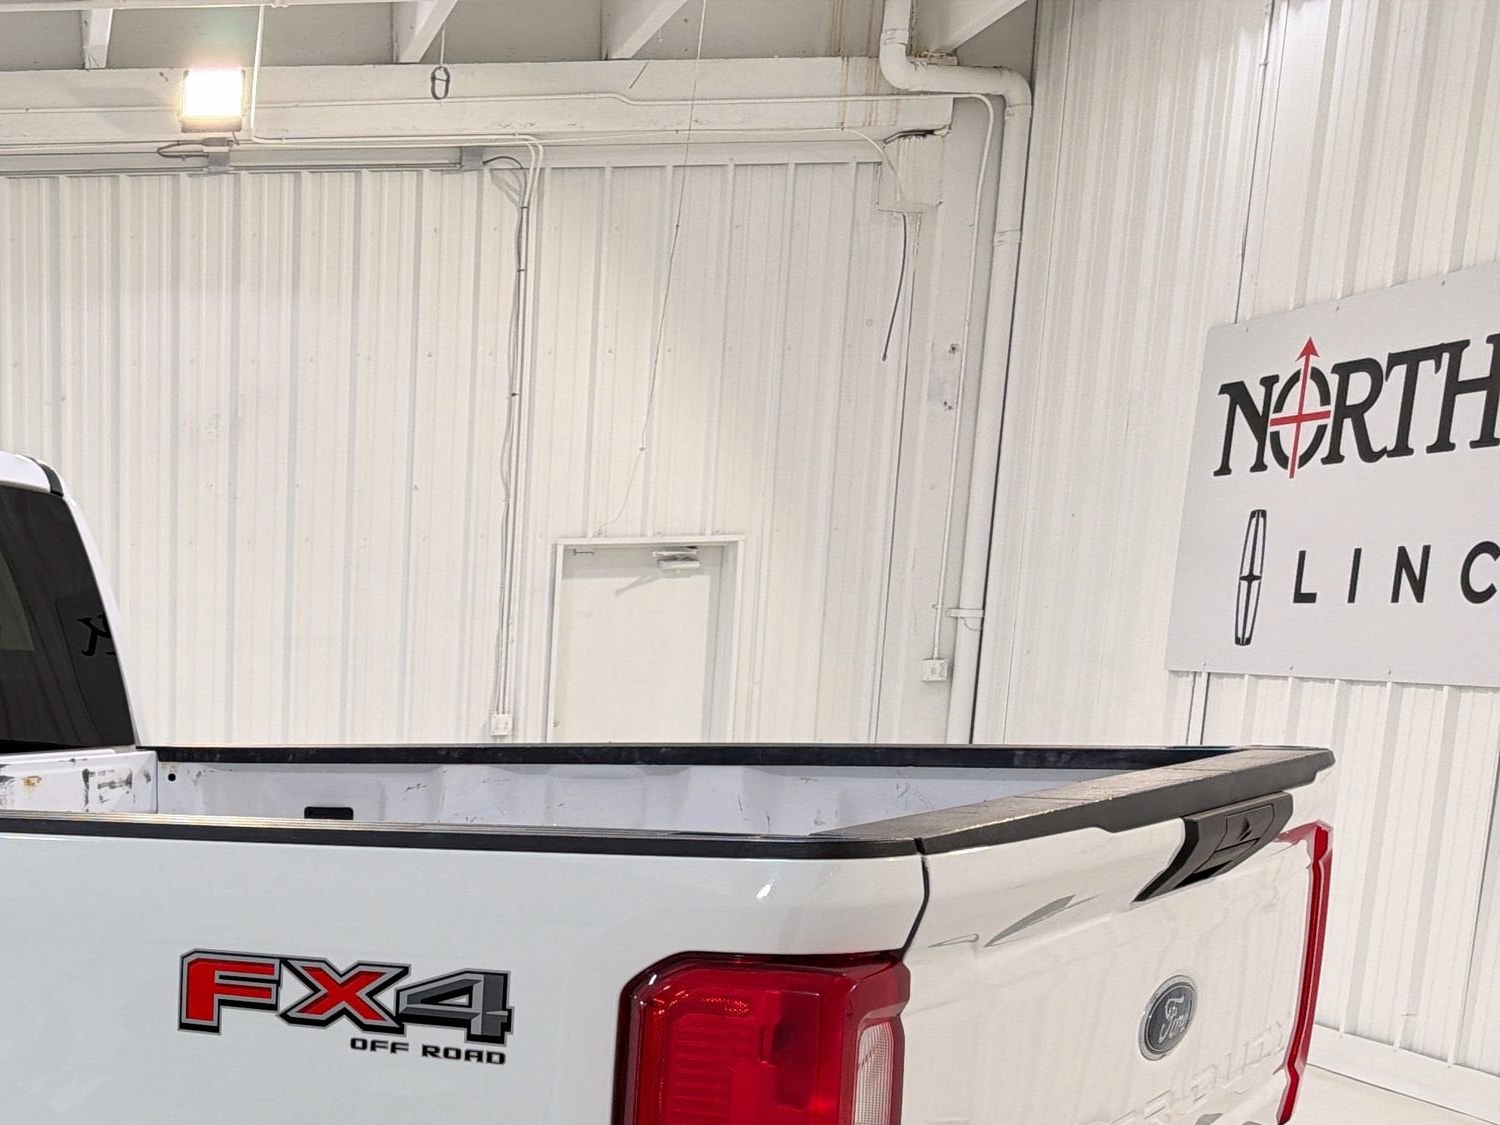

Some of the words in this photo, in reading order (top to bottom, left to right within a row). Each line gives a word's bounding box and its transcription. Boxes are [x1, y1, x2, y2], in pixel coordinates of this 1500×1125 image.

[179, 949, 513, 1044] FX4
[350, 1038, 409, 1054] OFF
[422, 1045, 506, 1065] ROAD
